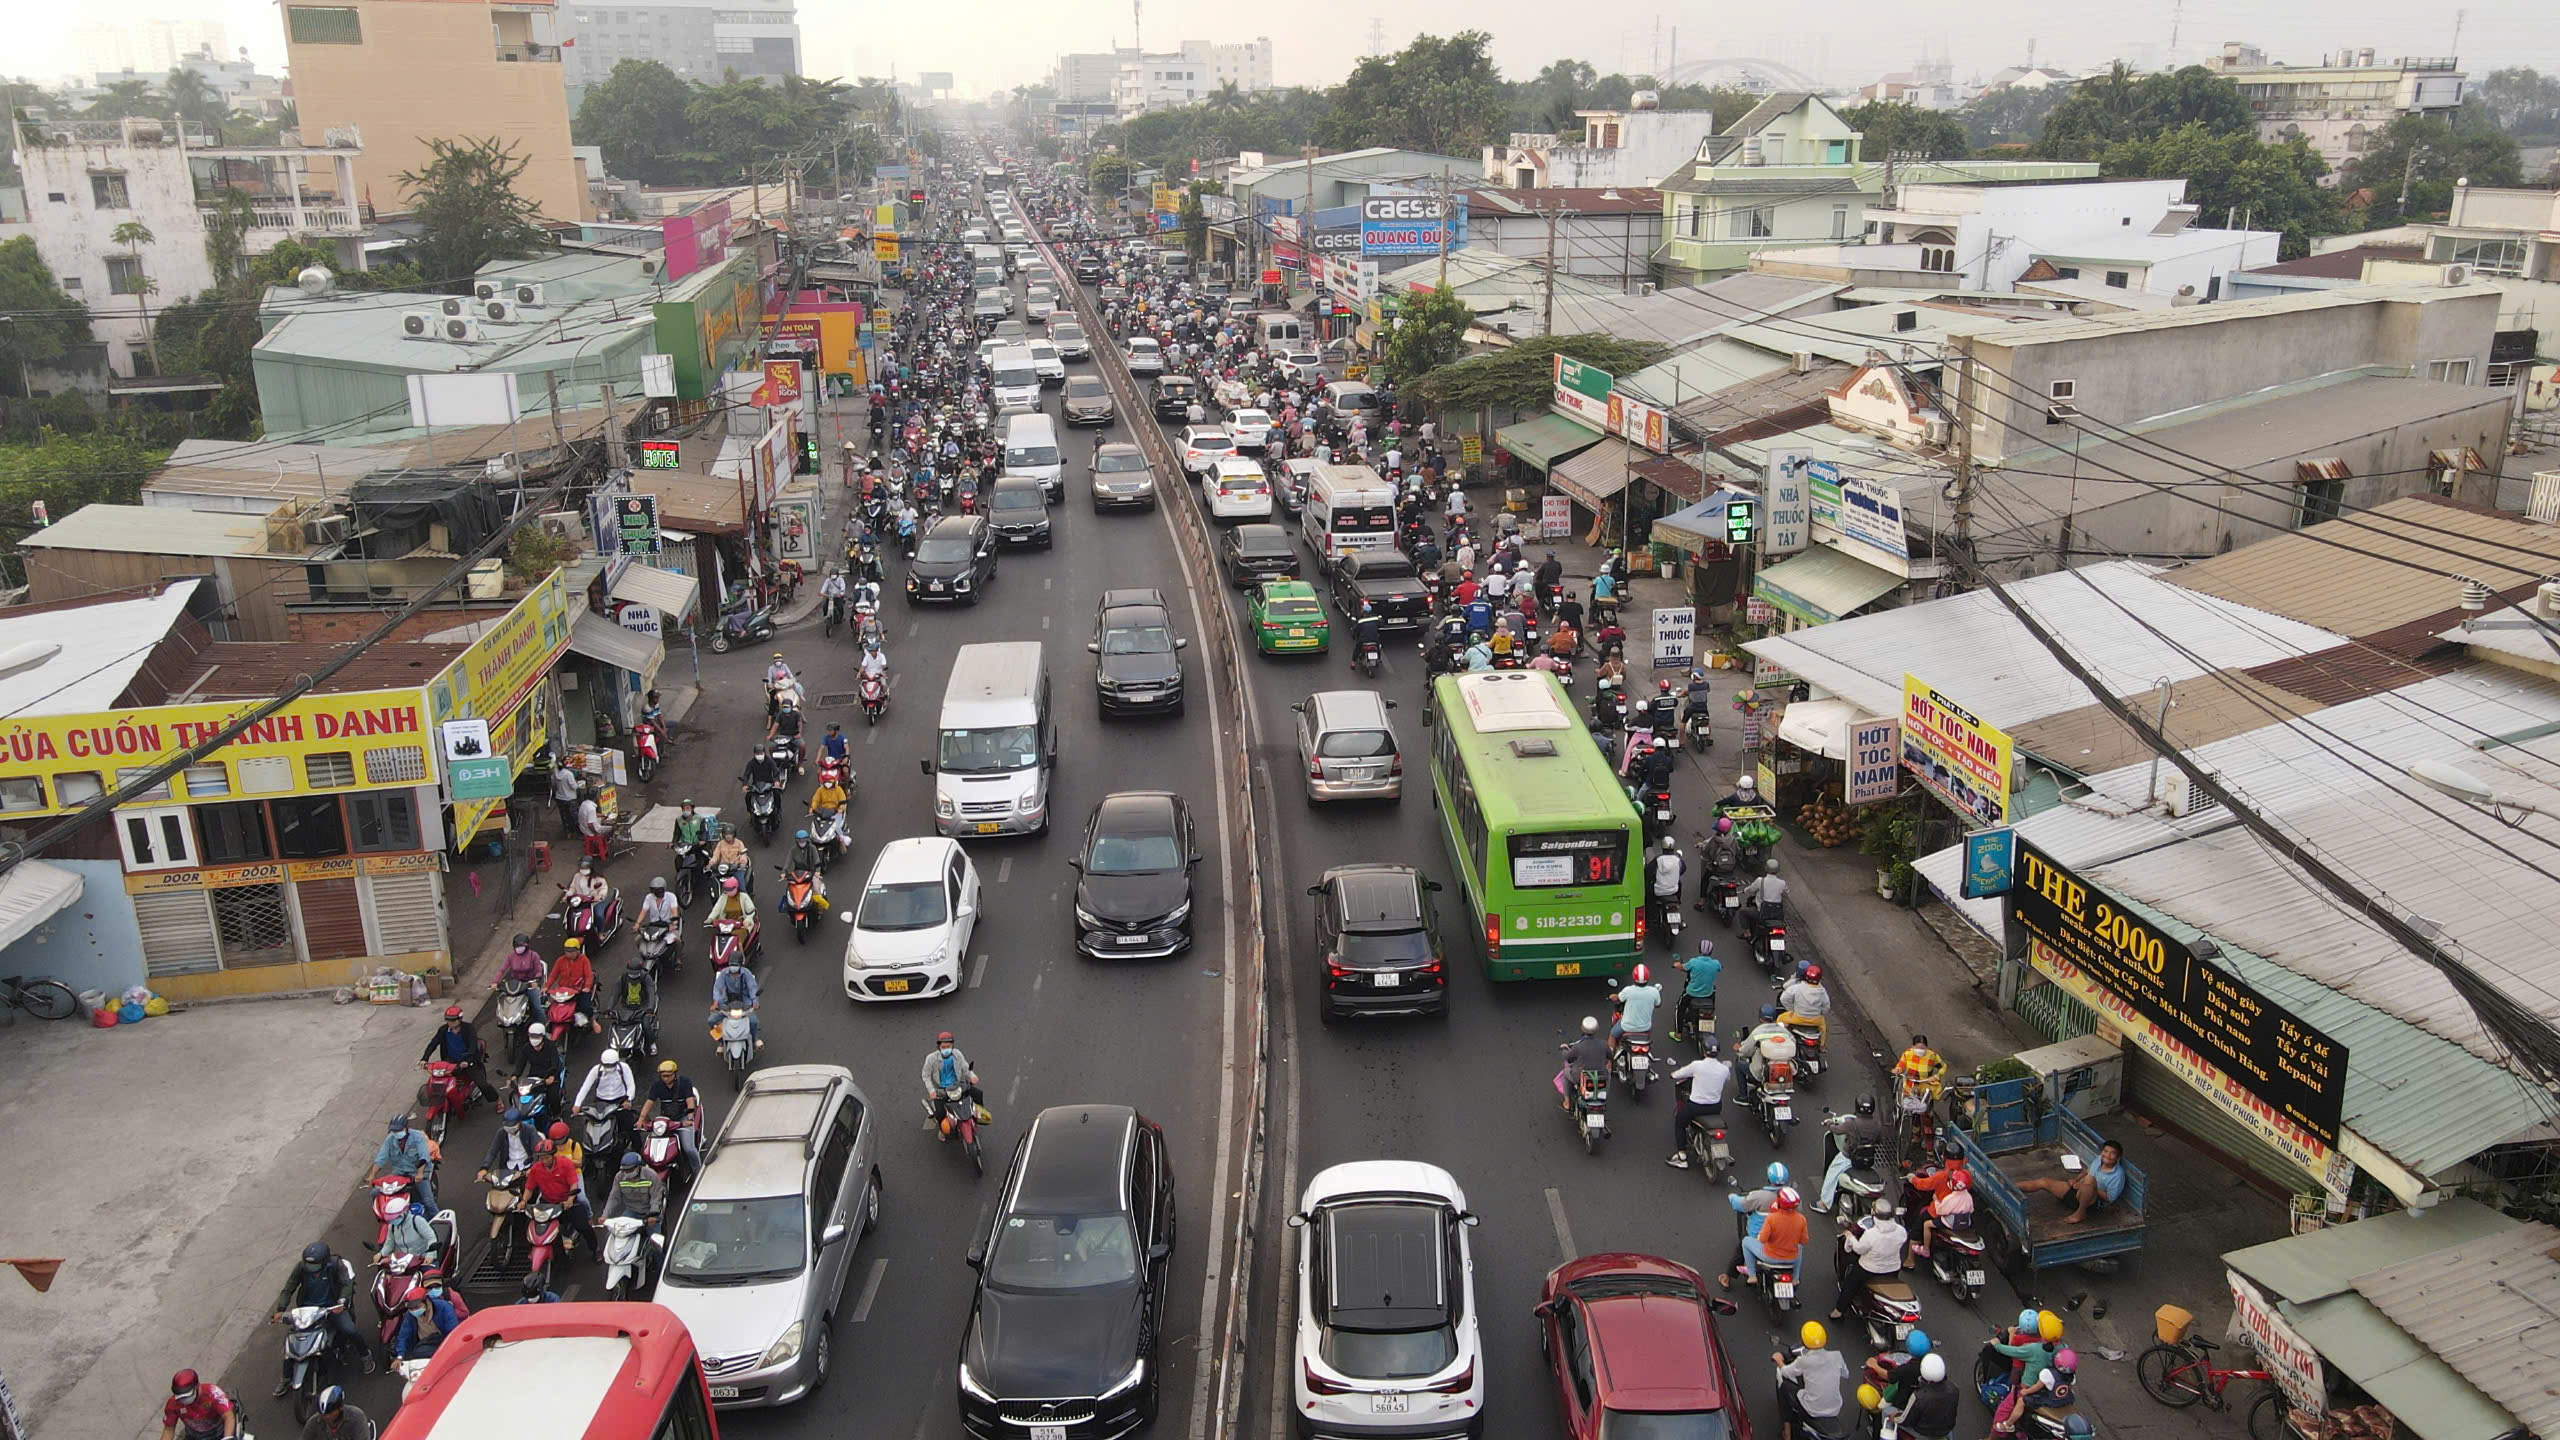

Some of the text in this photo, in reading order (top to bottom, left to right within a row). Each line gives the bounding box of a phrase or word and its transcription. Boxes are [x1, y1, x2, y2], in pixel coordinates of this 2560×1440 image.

[1365, 200, 1441, 218] caesa
[1314, 234, 1360, 248] caesa
[1365, 230, 1417, 245] QUANG
[643, 450, 678, 468] HOTEL
[1780, 484, 1800, 502] NHÀ
[624, 512, 649, 526] NHÀ
[1772, 504, 1804, 524] THUỐC
[621, 525, 656, 540] THUỐC
[1778, 528, 1798, 546] TÂY
[628, 608, 650, 620] NHÀ
[1673, 612, 1693, 624] NHÀ
[512, 622, 537, 655] DANH
[1659, 626, 1690, 640] THUỐC
[1665, 644, 1682, 656] TÂY
[67, 715, 162, 757] CUỐN
[171, 713, 304, 750] THÀNH
[314, 706, 419, 740] DANH
[1858, 726, 1891, 746] HỚT
[1911, 694, 1996, 766] HỚT TÓC NAM
[1859, 746, 1891, 765] TÓC
[1927, 730, 1944, 749] TÓC
[1976, 762, 2000, 786] KIỂU
[1854, 766, 1894, 786] NAM
[1540, 840, 1598, 850] SaigonBus
[322, 859, 354, 869] DOOR
[399, 855, 434, 865] DOOR
[1590, 856, 1610, 880] 91
[163, 873, 200, 884] DOOR
[242, 866, 278, 877] DOOR
[2023, 851, 2166, 974] THE 2000
[2060, 912, 2165, 989] sneaker care & authentic
[2201, 967, 2262, 1017] Vệ sinh giày
[2098, 954, 2120, 977] Cung
[2121, 970, 2140, 990] Cấp
[2141, 984, 2158, 1004] Các
[2180, 1011, 2204, 1038] Hàng
[2207, 1031, 2236, 1059] Chính
[2207, 990, 2250, 1027] Dán sole
[2204, 1004, 2251, 1046] Phủ nano
[2278, 1056, 2322, 1093] Repaint
[2150, 1042, 2163, 1056] 283
[2195, 1075, 2212, 1092] HIỆP
[2213, 1088, 2232, 1108] BÌNH
[2277, 1134, 2293, 1153] THỦ
[2294, 1146, 2312, 1168] ĐỨC
